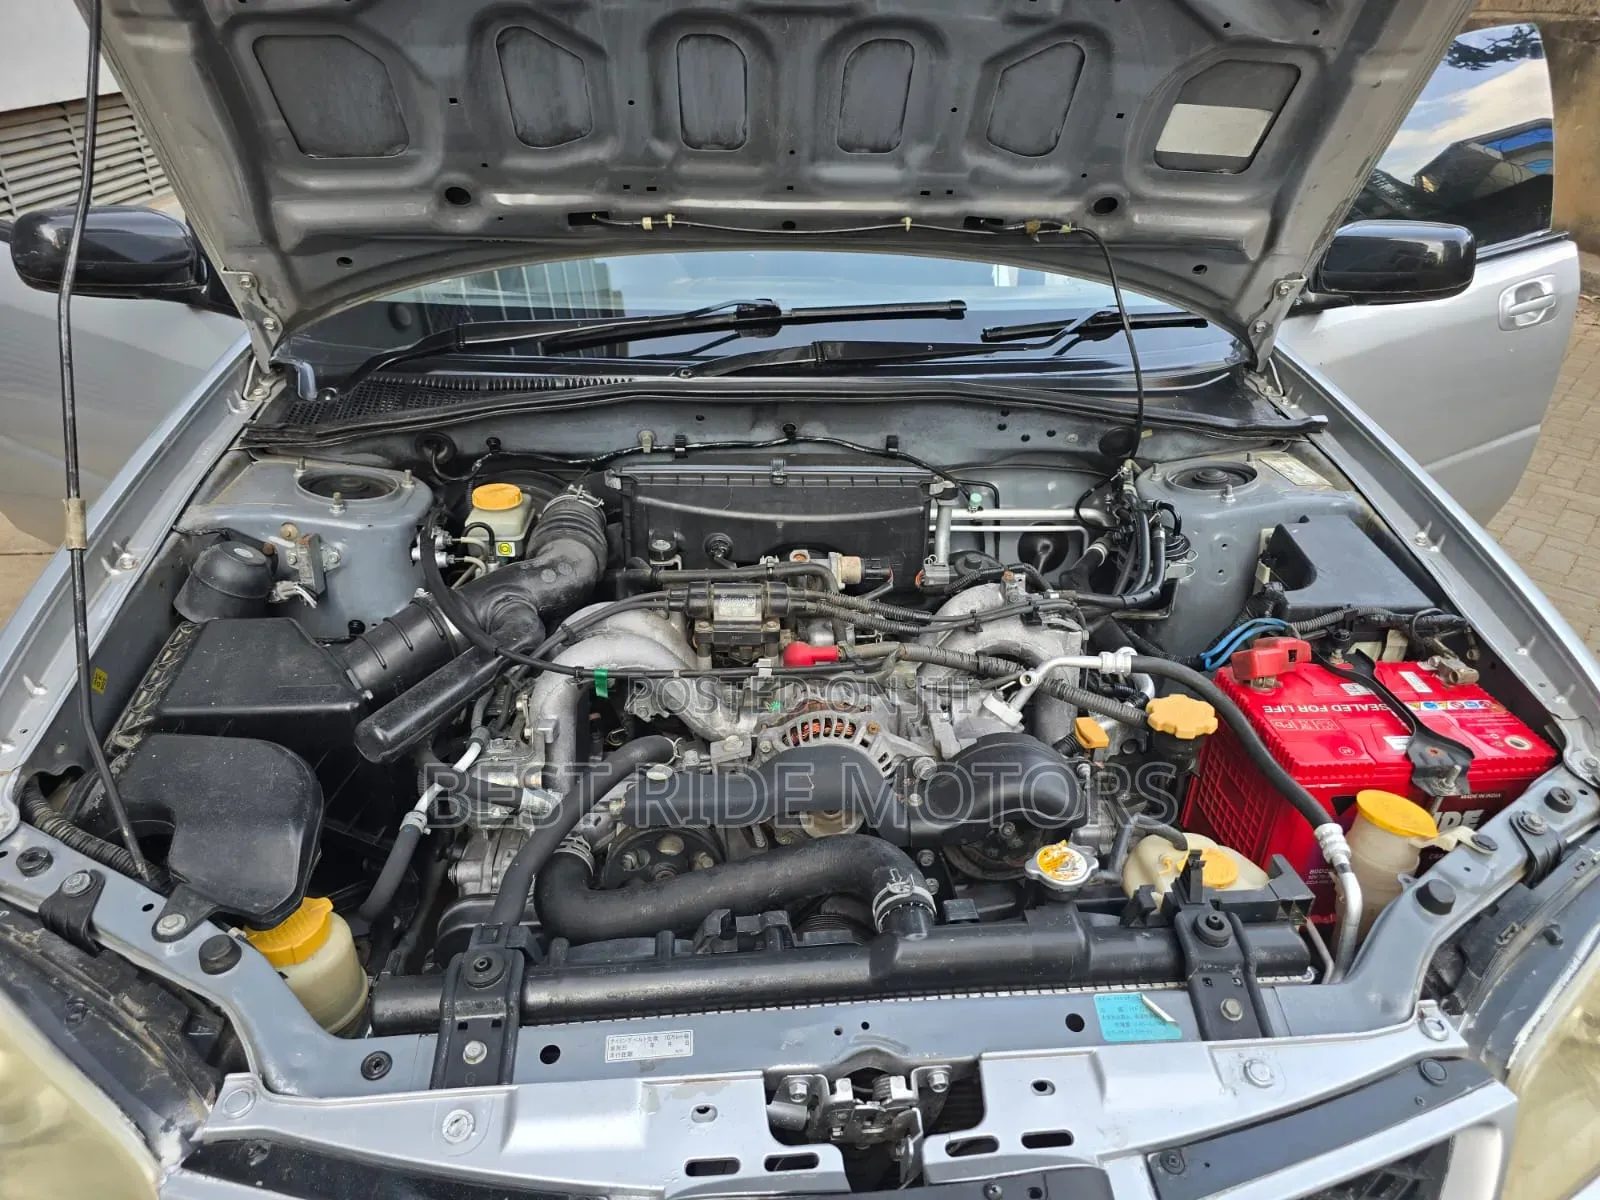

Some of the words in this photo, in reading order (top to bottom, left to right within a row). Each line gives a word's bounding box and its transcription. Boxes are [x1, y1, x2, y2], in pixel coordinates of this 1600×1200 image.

[1262, 705, 1295, 713] LIFE
[1299, 704, 1329, 713] FOR
[1331, 703, 1389, 712] SEALED
[1432, 809, 1485, 832] IDE
